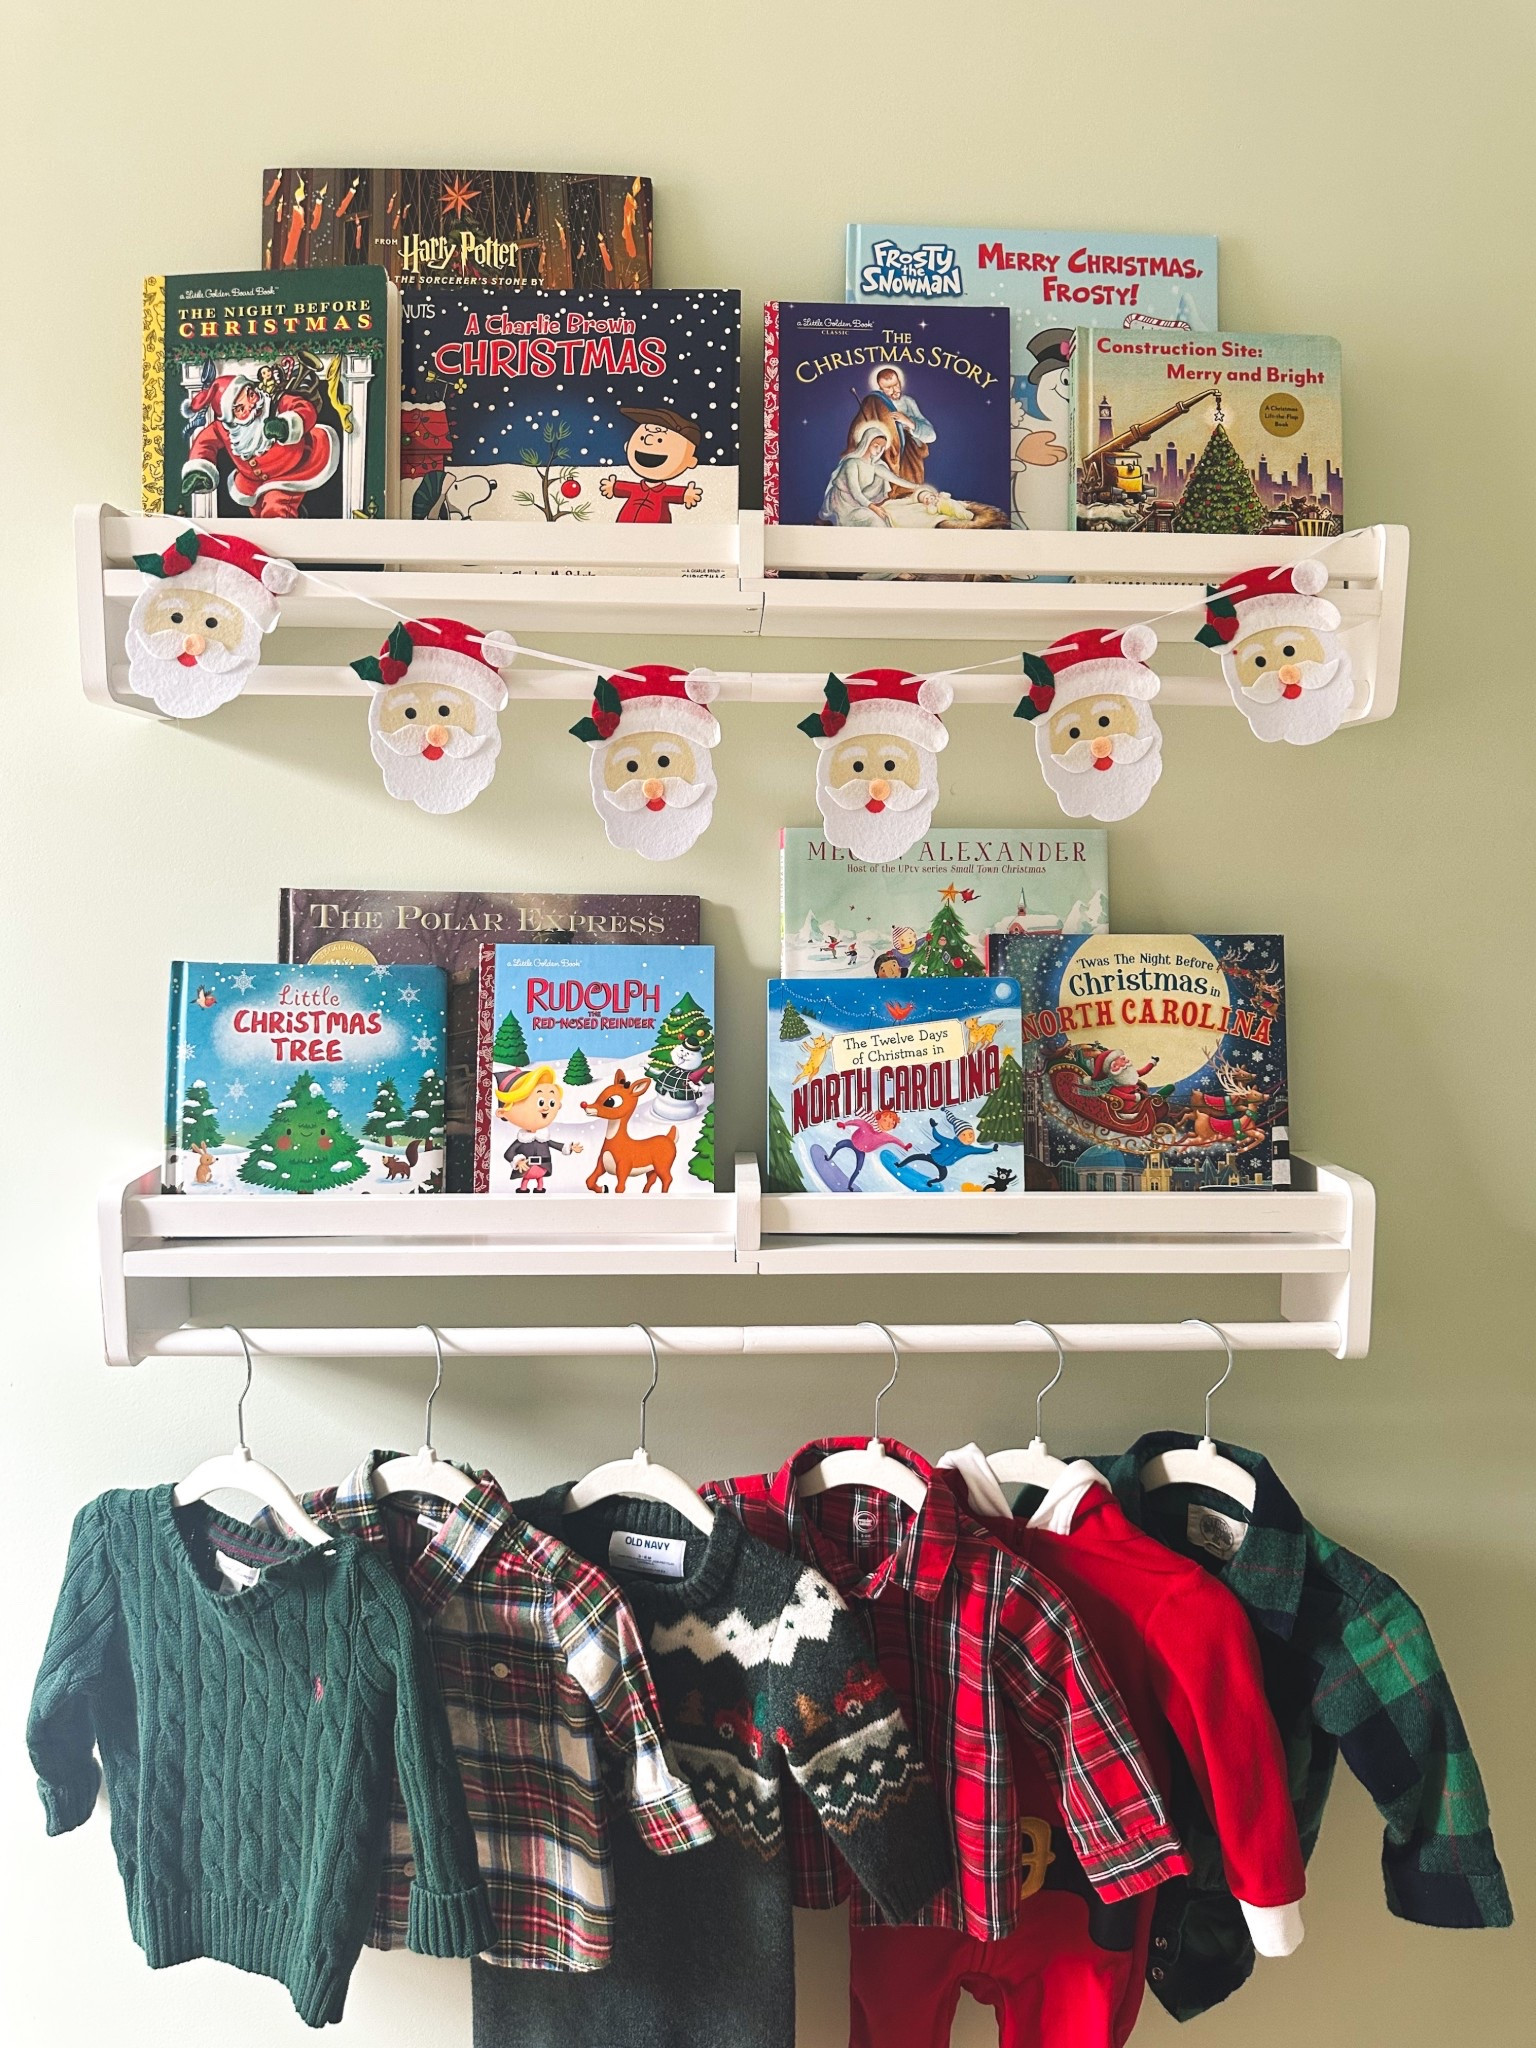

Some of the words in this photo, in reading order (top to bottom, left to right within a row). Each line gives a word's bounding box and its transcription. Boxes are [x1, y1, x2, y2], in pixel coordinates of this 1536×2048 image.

[374, 238, 398, 246] FROM
[398, 233, 457, 274] Harry
[460, 231, 520, 277] Potter
[873, 240, 954, 274] FROSTY
[978, 242, 1061, 273] MERRY
[1067, 247, 1204, 279] CHRISTMAS,
[394, 276, 416, 285] THE
[419, 276, 488, 286] SORCERER'S
[491, 276, 527, 286] STONE
[531, 277, 545, 287] BY
[901, 265, 926, 277] the
[185, 289, 204, 300] Little
[205, 288, 231, 299] Golden
[231, 287, 255, 297] Board
[255, 285, 275, 296] Book
[1043, 275, 1140, 306] FROSTY!
[178, 308, 217, 321] THE
[224, 303, 287, 319] NIGHT
[294, 299, 372, 315] BEFORE
[402, 303, 437, 319] NUTS
[178, 313, 373, 339] CHRISTMAS
[464, 312, 480, 336] A
[485, 312, 561, 336] Charlie
[566, 312, 637, 335] Brown
[802, 317, 824, 327] Little
[824, 317, 852, 328] Golden
[852, 319, 873, 328] Book
[881, 329, 913, 344] THE
[1097, 337, 1217, 356] Construction
[1221, 341, 1263, 358] Site:
[434, 335, 668, 379] CHRISTMAS
[795, 345, 926, 384] CHRISTMAS
[927, 346, 999, 390] STORY
[1166, 363, 1223, 385] Merry
[1227, 366, 1262, 382] and
[1266, 366, 1325, 388] Bright
[917, 841, 1087, 862] ALEXANDER
[847, 864, 867, 873] Host
[869, 864, 879, 873] of
[881, 864, 896, 873] the
[922, 864, 948, 873] series
[950, 864, 974, 874] Small
[977, 864, 999, 874] Town
[1001, 864, 1047, 874] Christmas
[310, 903, 383, 929] THE
[395, 905, 503, 931] POLAR
[517, 907, 666, 934] EXPRESS
[512, 958, 533, 967] Little
[533, 958, 561, 968] Golden
[560, 958, 581, 967] Book
[1114, 953, 1135, 965] The
[1139, 952, 1171, 967] Night
[1175, 955, 1214, 971] Before
[1069, 967, 1208, 997] Christmas
[1210, 985, 1221, 998] in
[278, 984, 341, 1007] Little
[526, 977, 661, 1014] RUDOLPH
[233, 1009, 382, 1035] CHRISTMAS
[532, 1016, 599, 1031] RED-NOSED
[600, 1017, 656, 1030] REINDEER
[1022, 999, 1116, 1044] NORTH
[1120, 998, 1273, 1046] CAROLINA
[270, 1037, 344, 1062] TREE
[843, 1037, 868, 1051] The
[870, 1031, 915, 1048] Twelve
[919, 1029, 948, 1045] Days
[852, 1053, 864, 1066] of
[867, 1048, 929, 1063] Christmas
[933, 1044, 945, 1055] in
[791, 1066, 872, 1136] NORTH
[877, 1044, 1000, 1114] CAROLINA
[625, 1536, 643, 1547] OLD
[644, 1539, 670, 1551] NAVY
